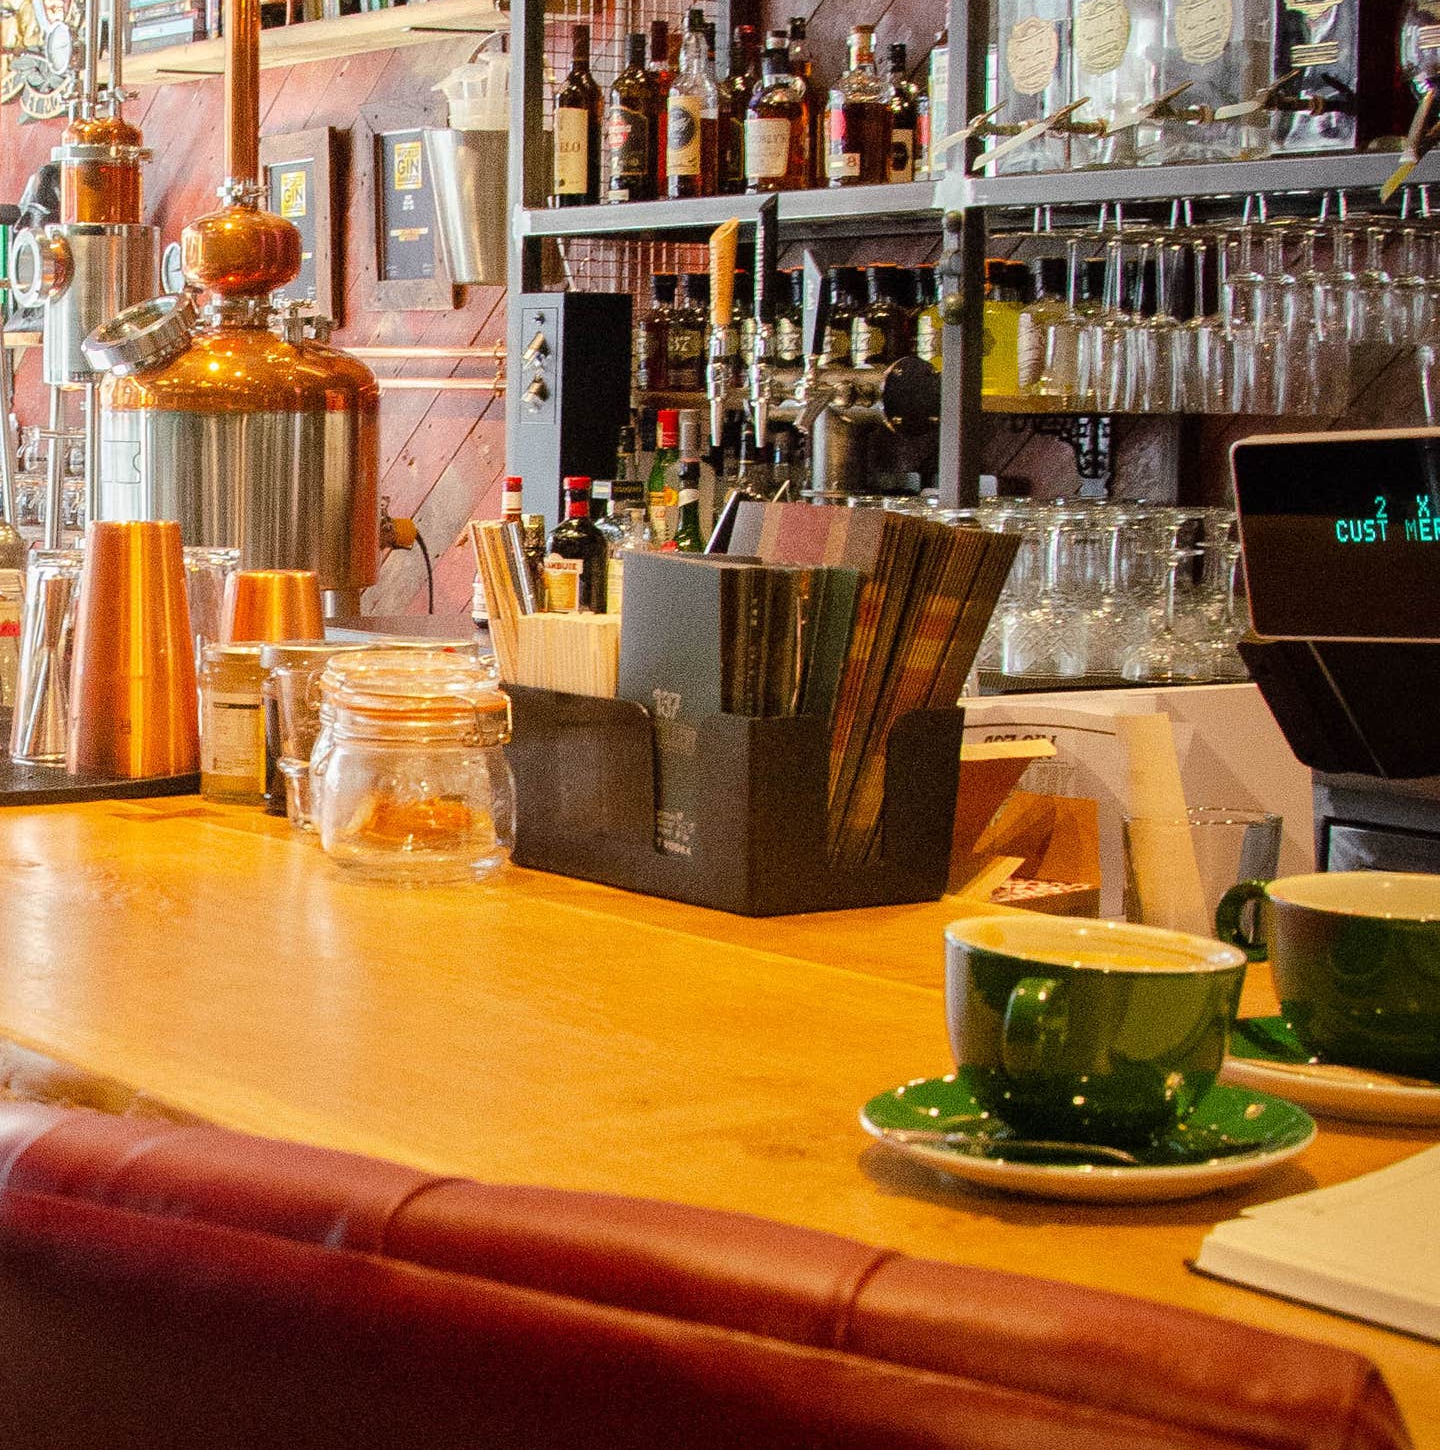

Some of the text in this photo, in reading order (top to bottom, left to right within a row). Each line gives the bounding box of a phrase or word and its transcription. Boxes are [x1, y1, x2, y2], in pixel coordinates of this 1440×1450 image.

[397, 157, 420, 176] GIN
[1374, 494, 1431, 519] 2 X
[1335, 518, 1389, 543] CUST
